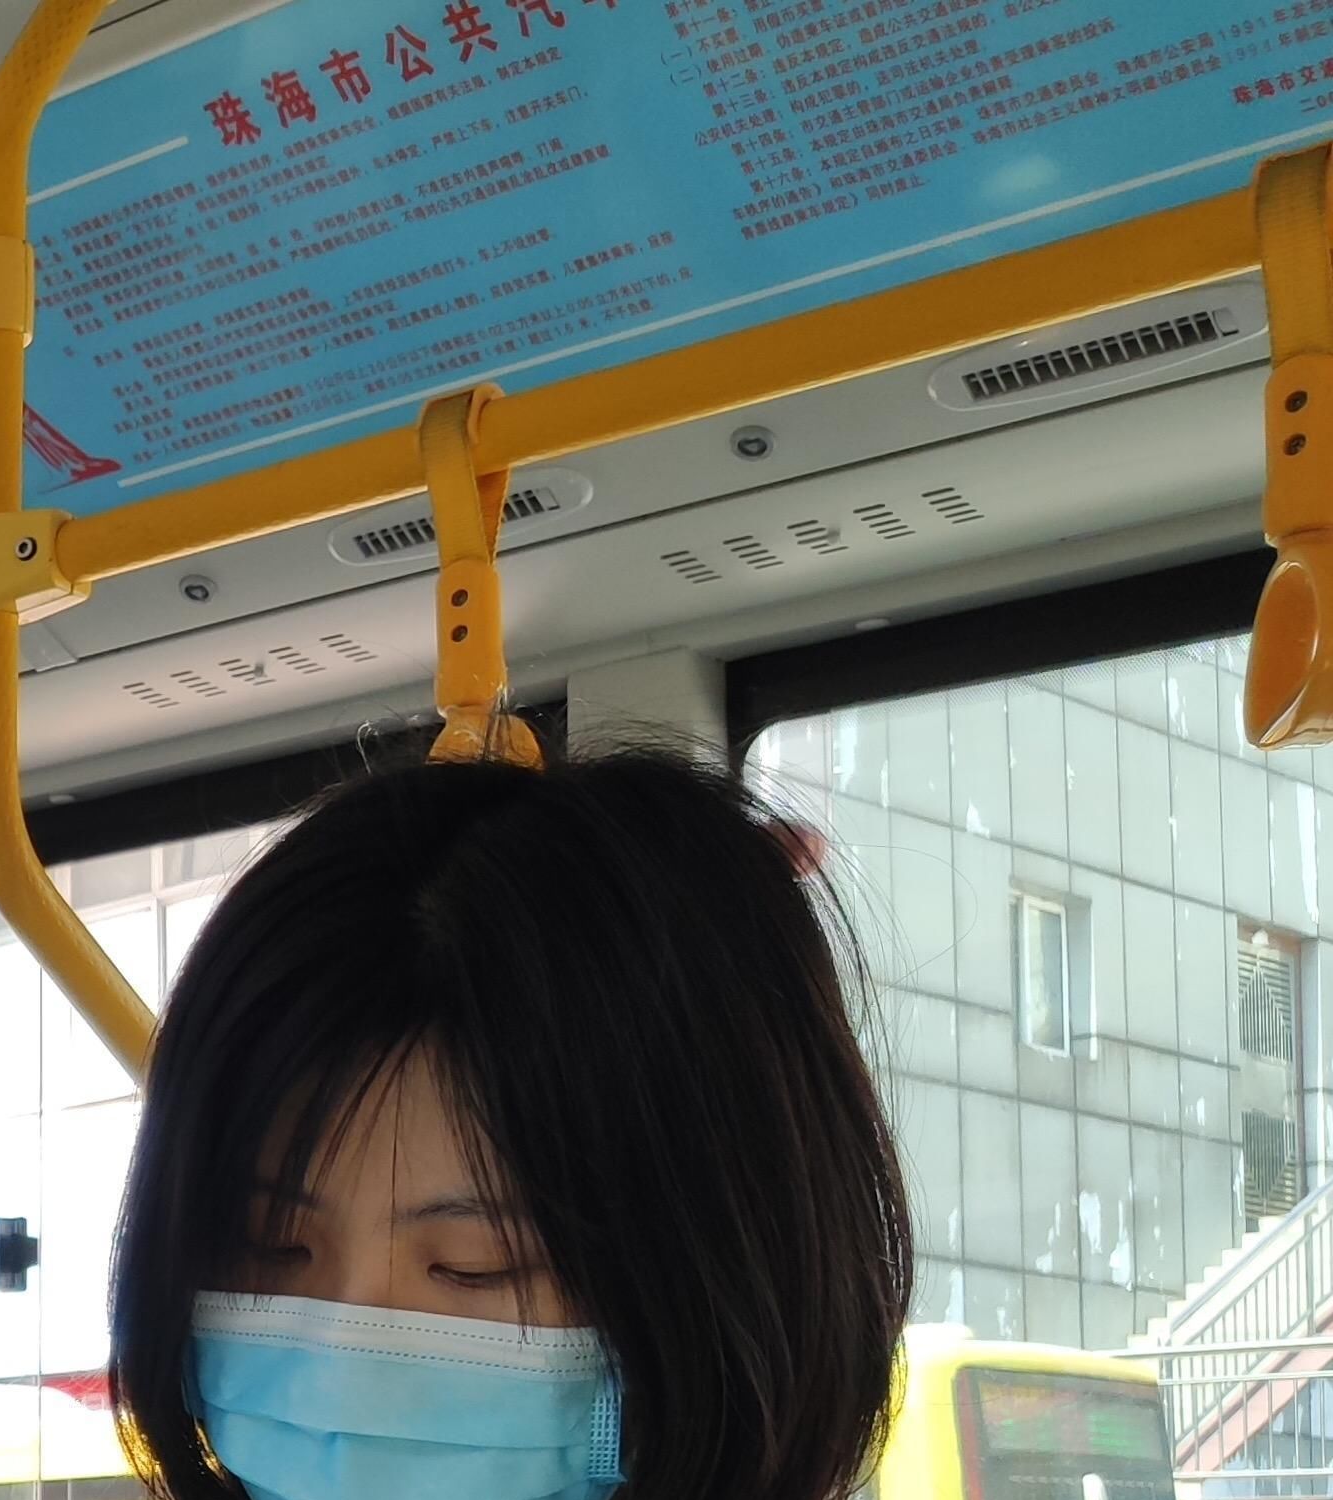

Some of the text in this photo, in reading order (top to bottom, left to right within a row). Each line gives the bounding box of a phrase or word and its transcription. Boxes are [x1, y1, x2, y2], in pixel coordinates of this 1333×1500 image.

[203, 0, 617, 147] 珠海市公共汽
